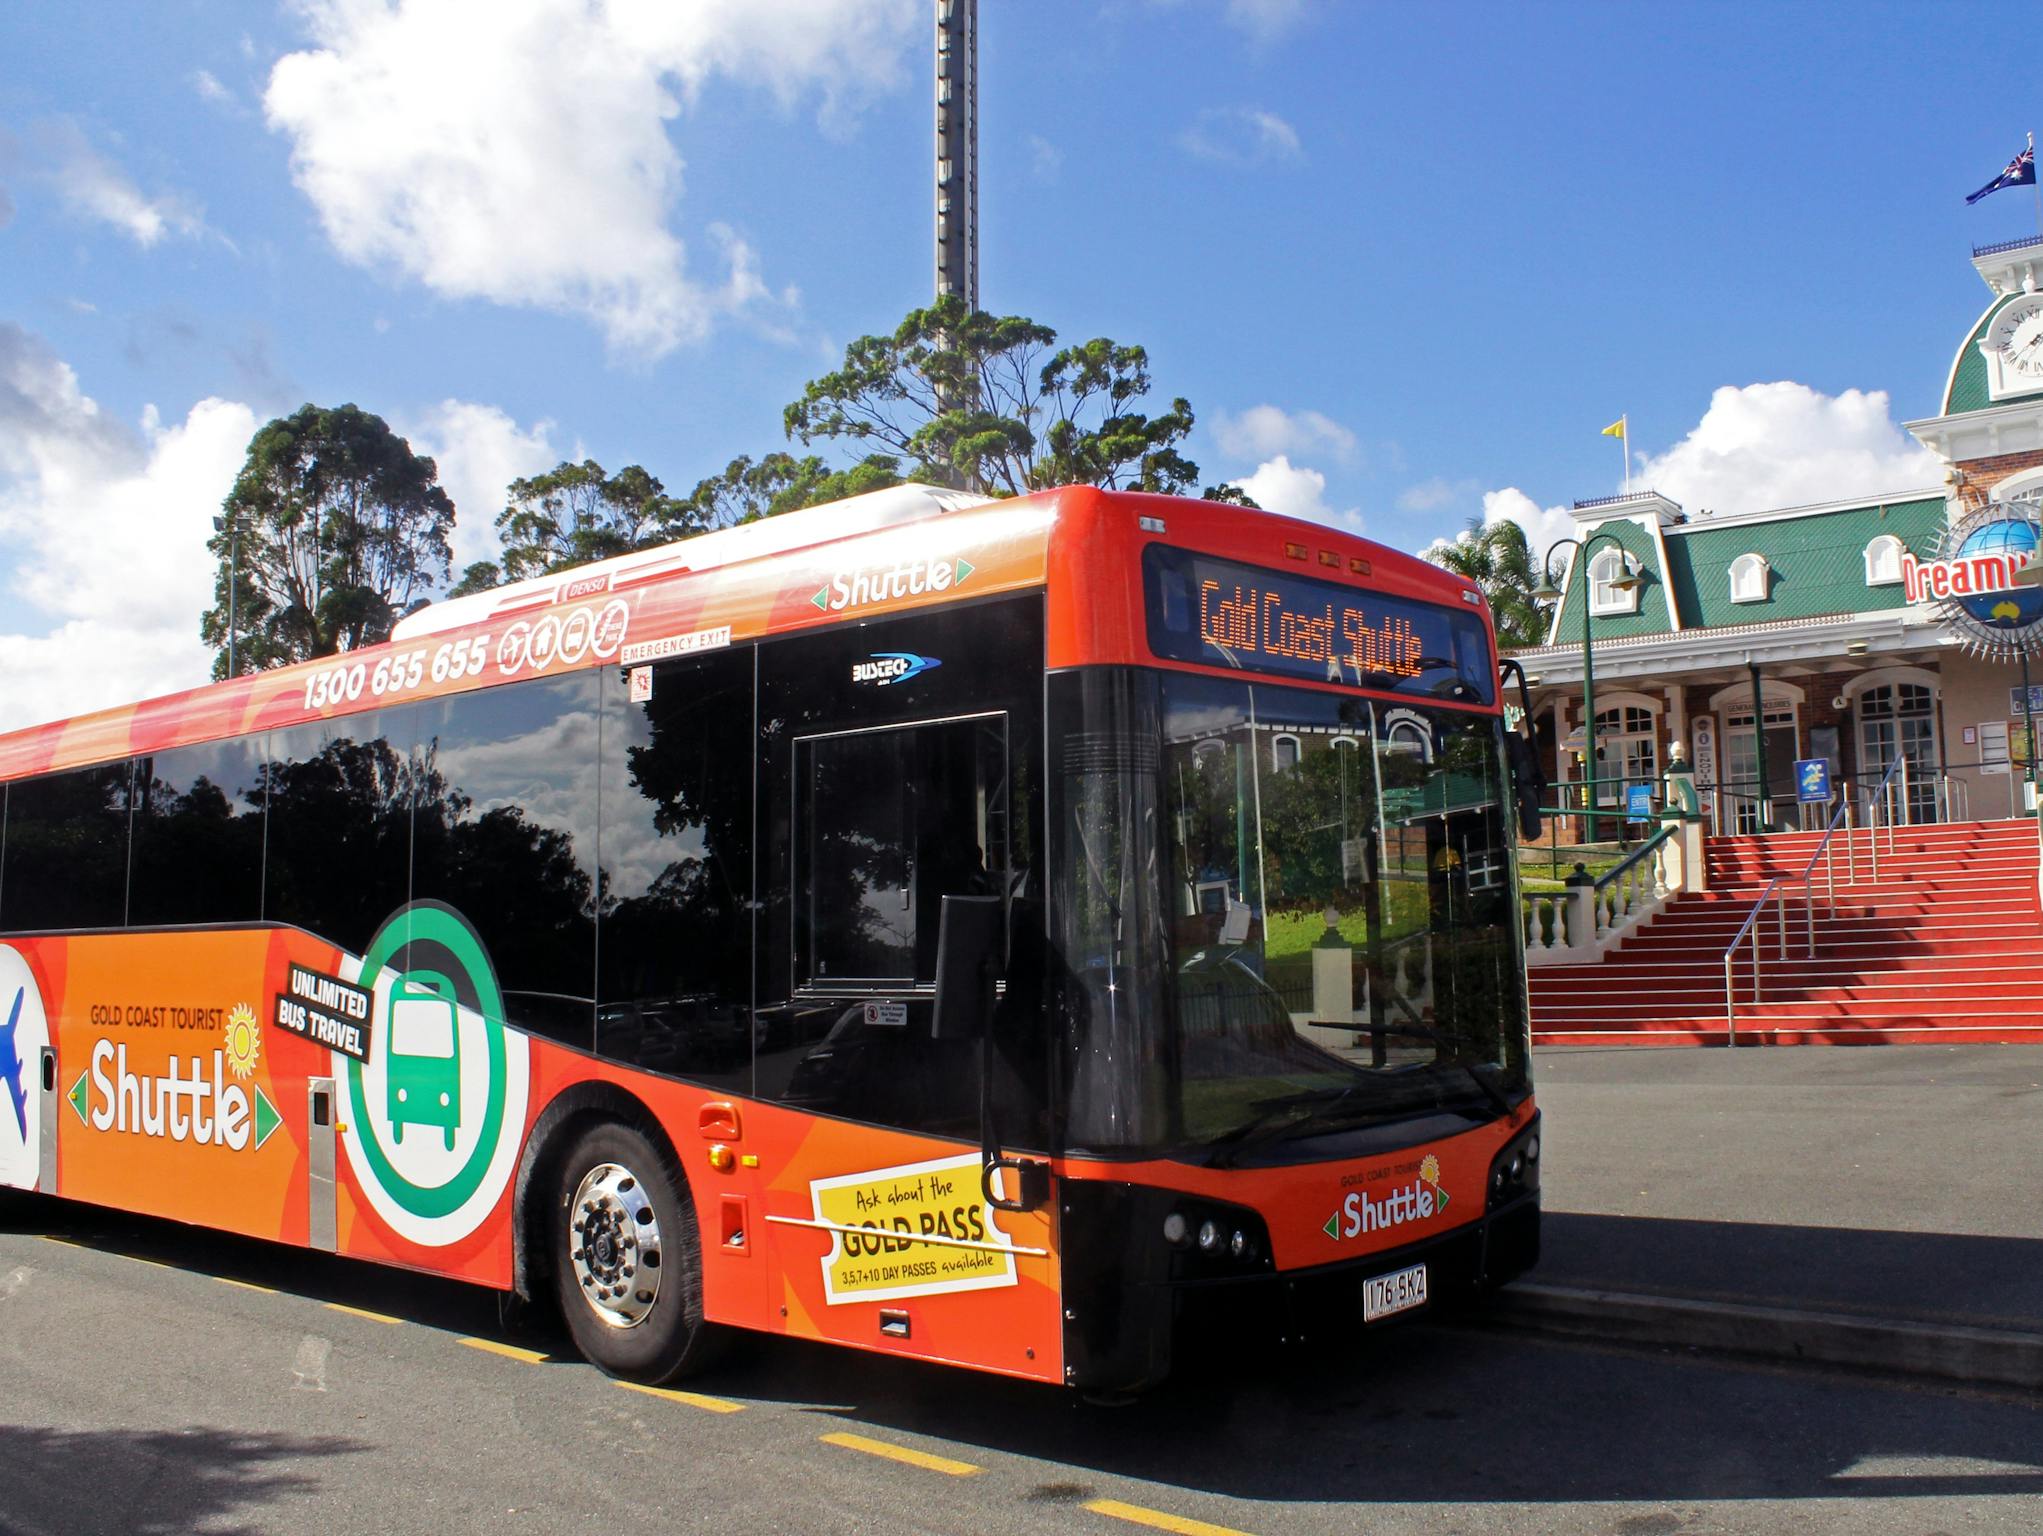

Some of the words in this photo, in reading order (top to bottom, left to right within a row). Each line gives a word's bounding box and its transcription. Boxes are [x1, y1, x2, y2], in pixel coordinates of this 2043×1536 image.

[570, 577, 605, 597] DENSO
[830, 556, 952, 610] Shuttle
[623, 638, 693, 661] EMERGENCY
[699, 630, 729, 648] EXIT
[1201, 579, 1257, 651] Gold
[1263, 592, 1336, 664] Coast
[1343, 608, 1422, 678] Shuttle
[304, 663, 367, 710] 1300
[371, 650, 427, 696] 655
[431, 634, 487, 683] 655
[90, 1004, 121, 1026] GOLD
[126, 1007, 166, 1029] COAST
[170, 1008, 225, 1031] TOURIST
[292, 968, 368, 1020] UNLIMITED
[279, 999, 306, 1031] BUS
[309, 1012, 364, 1056] TRAVEL
[91, 1039, 251, 1152] Shuttle
[857, 1190, 881, 1213] Ask
[888, 1179, 924, 1204] about
[930, 1176, 953, 1200] the
[1341, 1173, 1364, 1188] GOLD
[1367, 1167, 1391, 1182] COAST
[842, 1216, 912, 1258] GOLD
[919, 1204, 985, 1248] PASS
[1343, 1179, 1434, 1238] Shuttle
[842, 1267, 880, 1286] 3,5,7+10
[883, 1265, 900, 1281] DAY
[902, 1261, 937, 1279] PASSES
[942, 1253, 994, 1273] available
